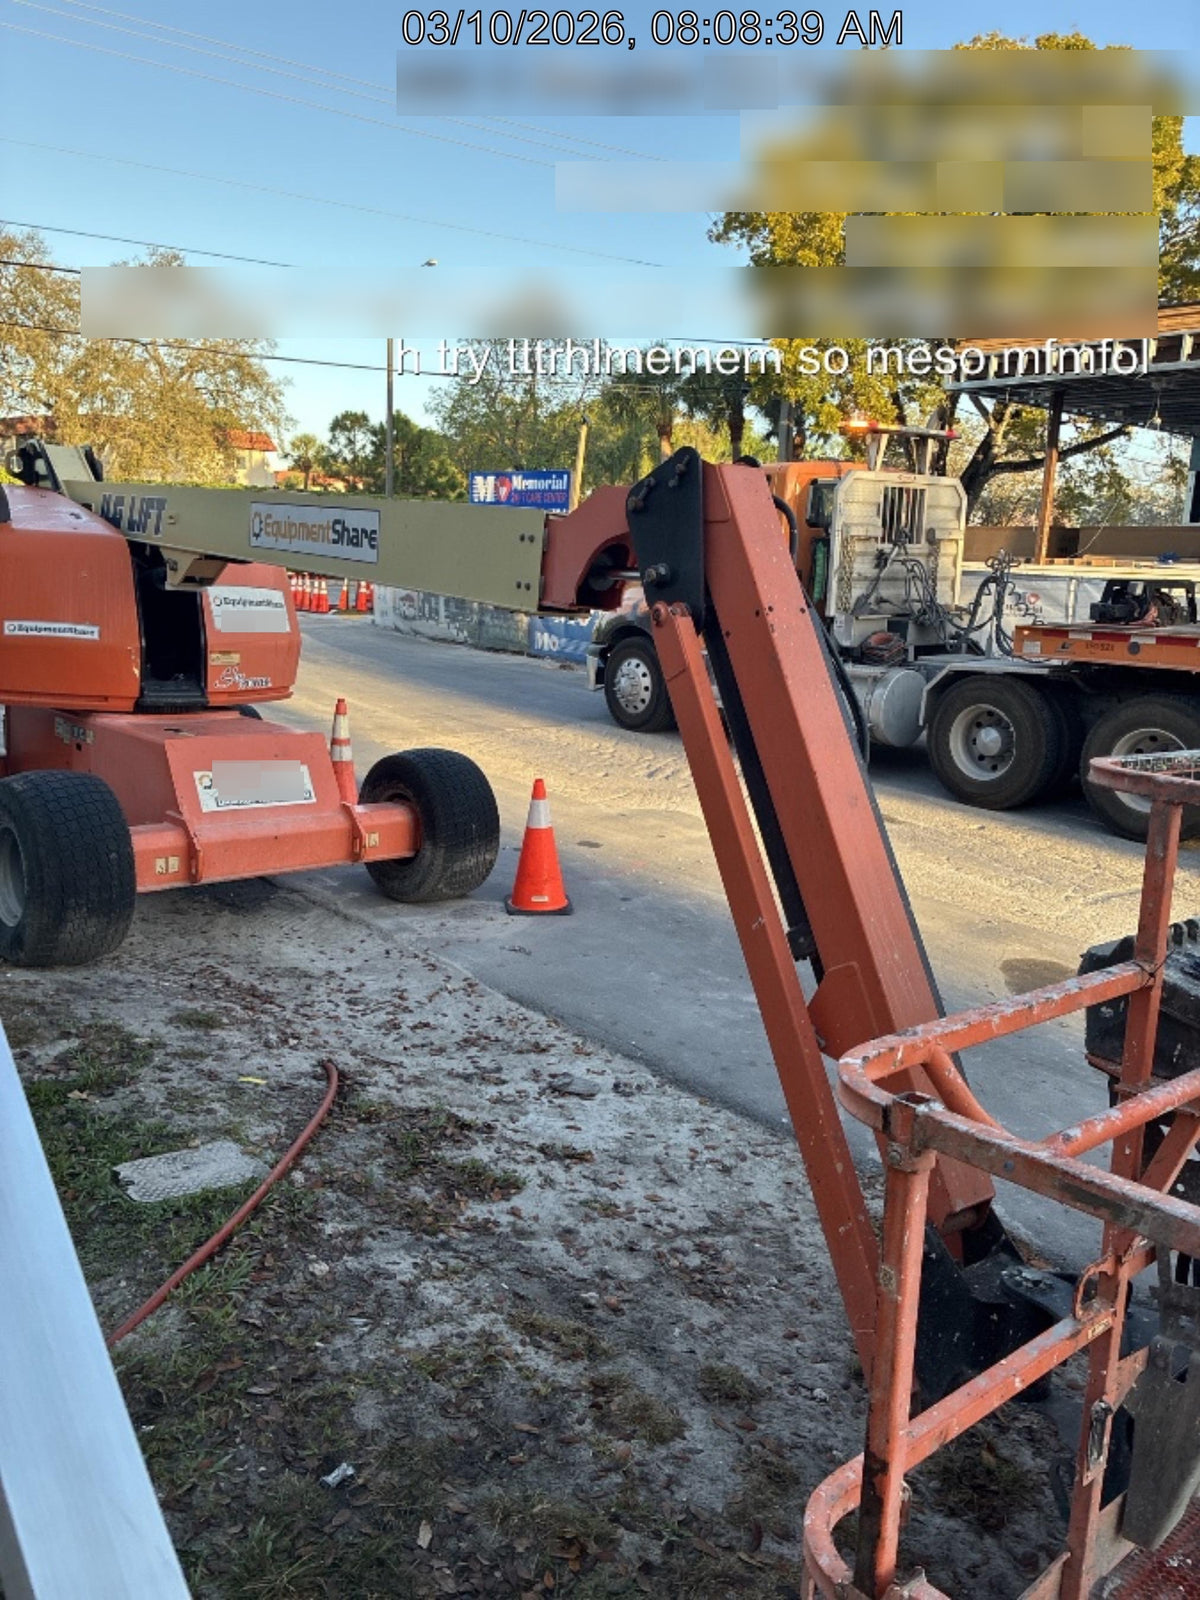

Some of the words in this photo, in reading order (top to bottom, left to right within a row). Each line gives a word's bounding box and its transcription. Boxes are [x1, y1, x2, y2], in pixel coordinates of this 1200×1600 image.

[511, 474, 568, 491] Memorial
[127, 494, 167, 537] LIFT
[263, 512, 378, 550] EquipmentShare
